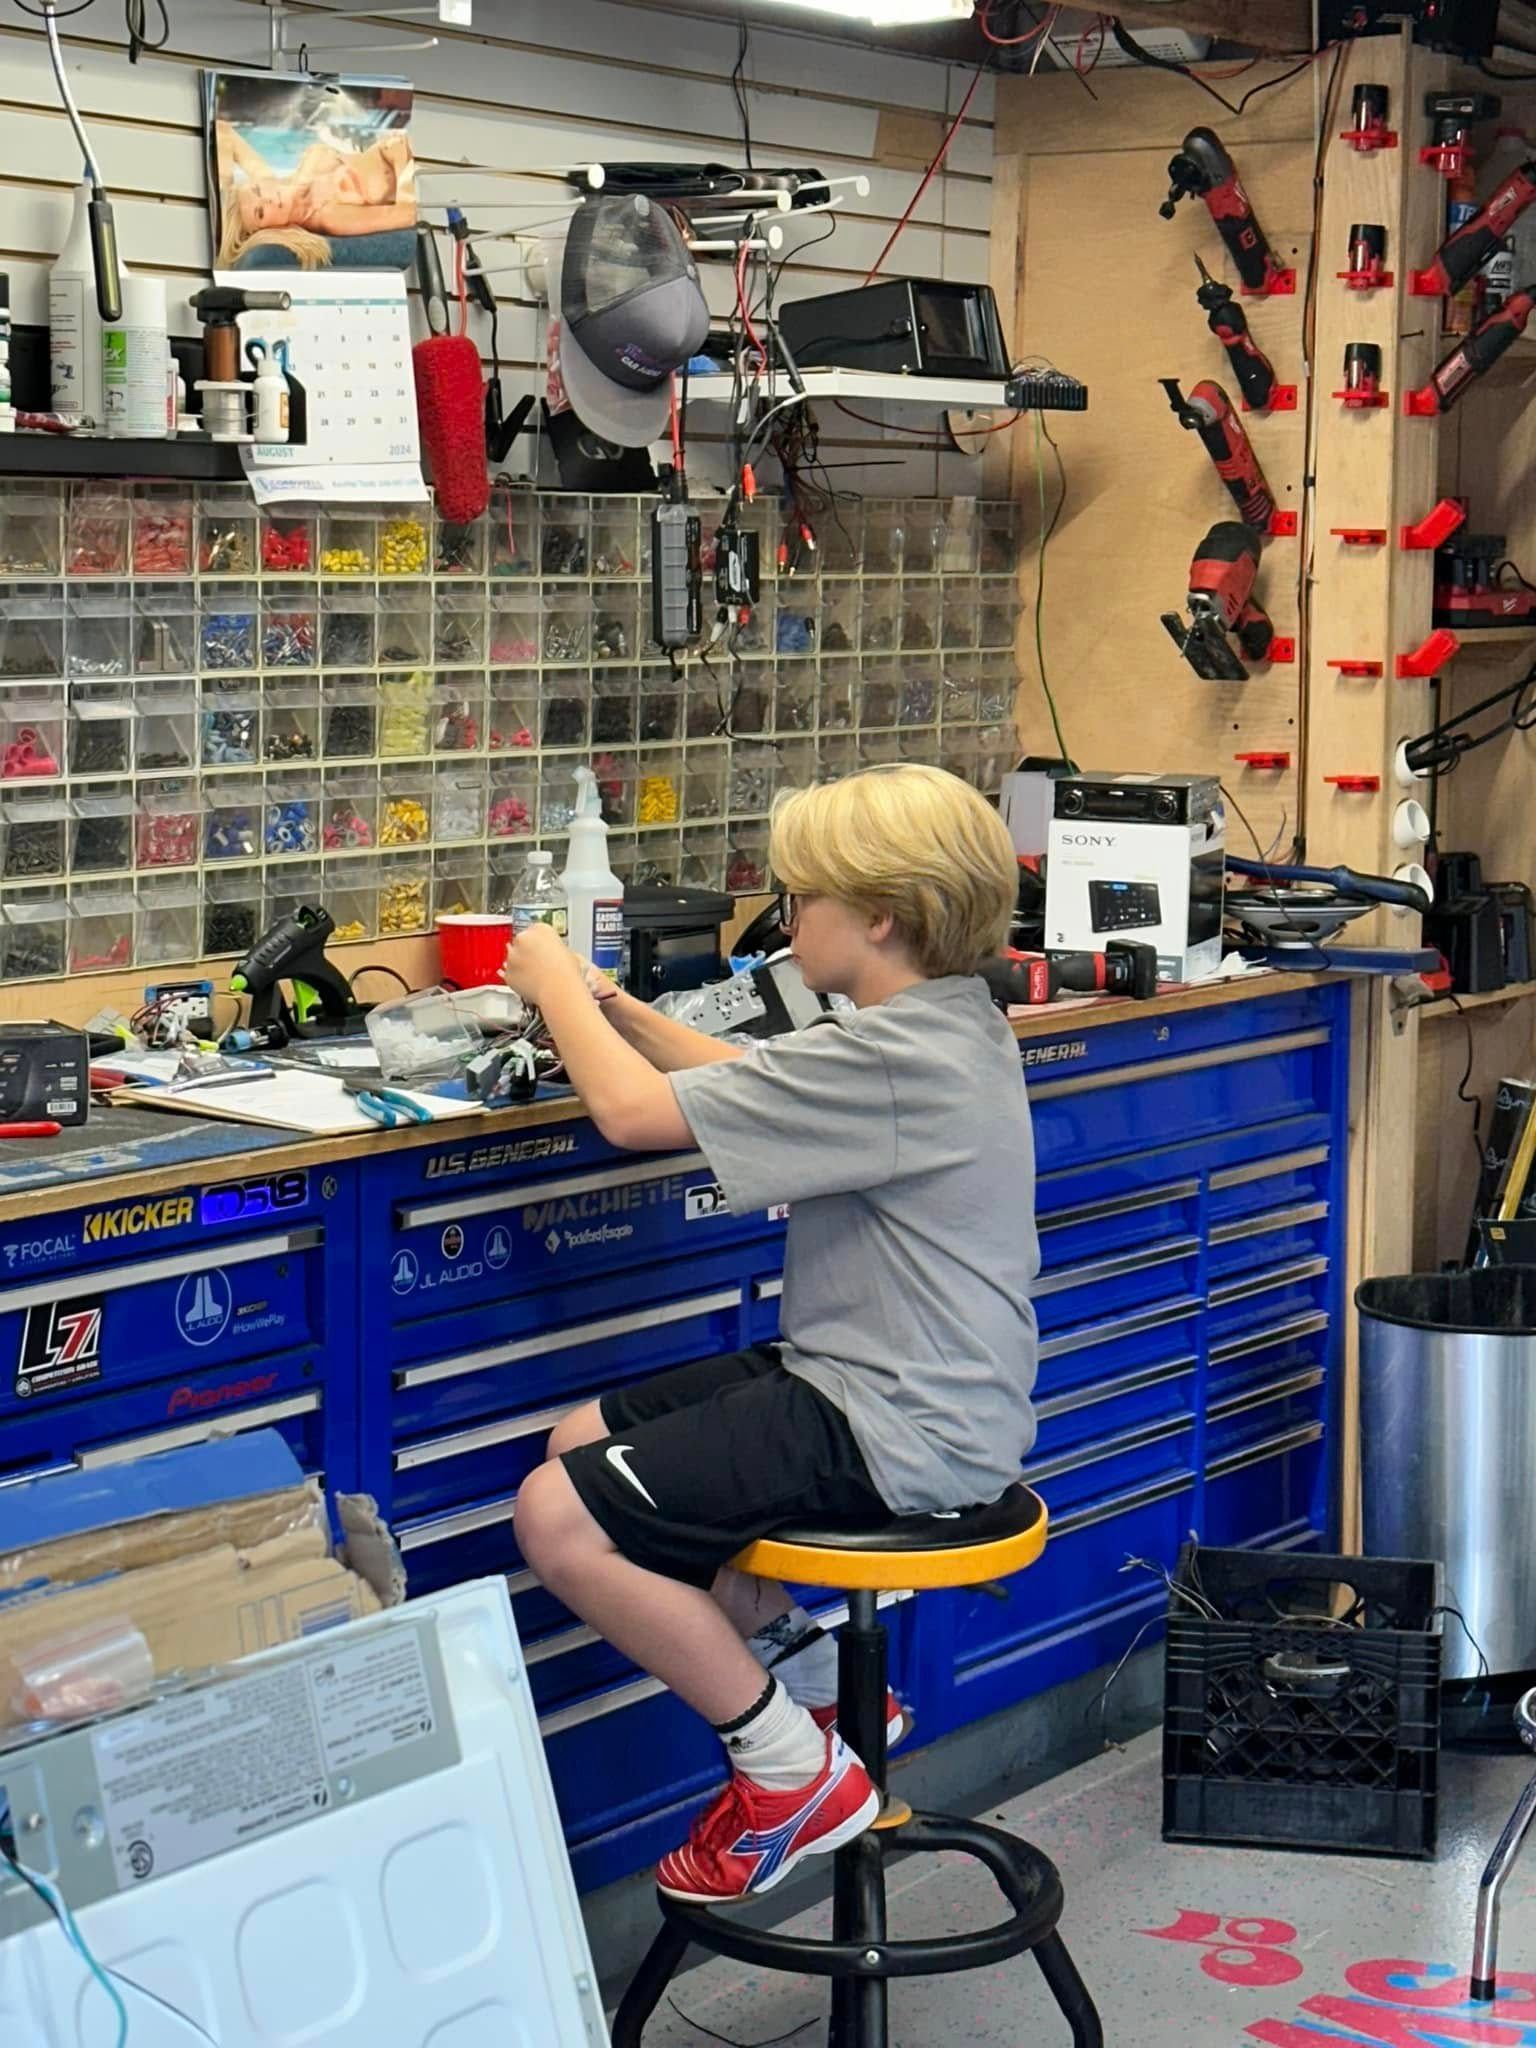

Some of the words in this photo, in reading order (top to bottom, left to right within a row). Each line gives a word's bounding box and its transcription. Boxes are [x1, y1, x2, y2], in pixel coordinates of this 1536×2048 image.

[256, 446, 294, 458] AUGUST
[389, 445, 412, 456] 2024
[1061, 834, 1116, 847] SONY
[469, 1134, 579, 1171] GENERAL
[102, 1196, 195, 1240] KICKER
[21, 1236, 75, 1260] FOCAL
[439, 1262, 483, 1285] AUDIO
